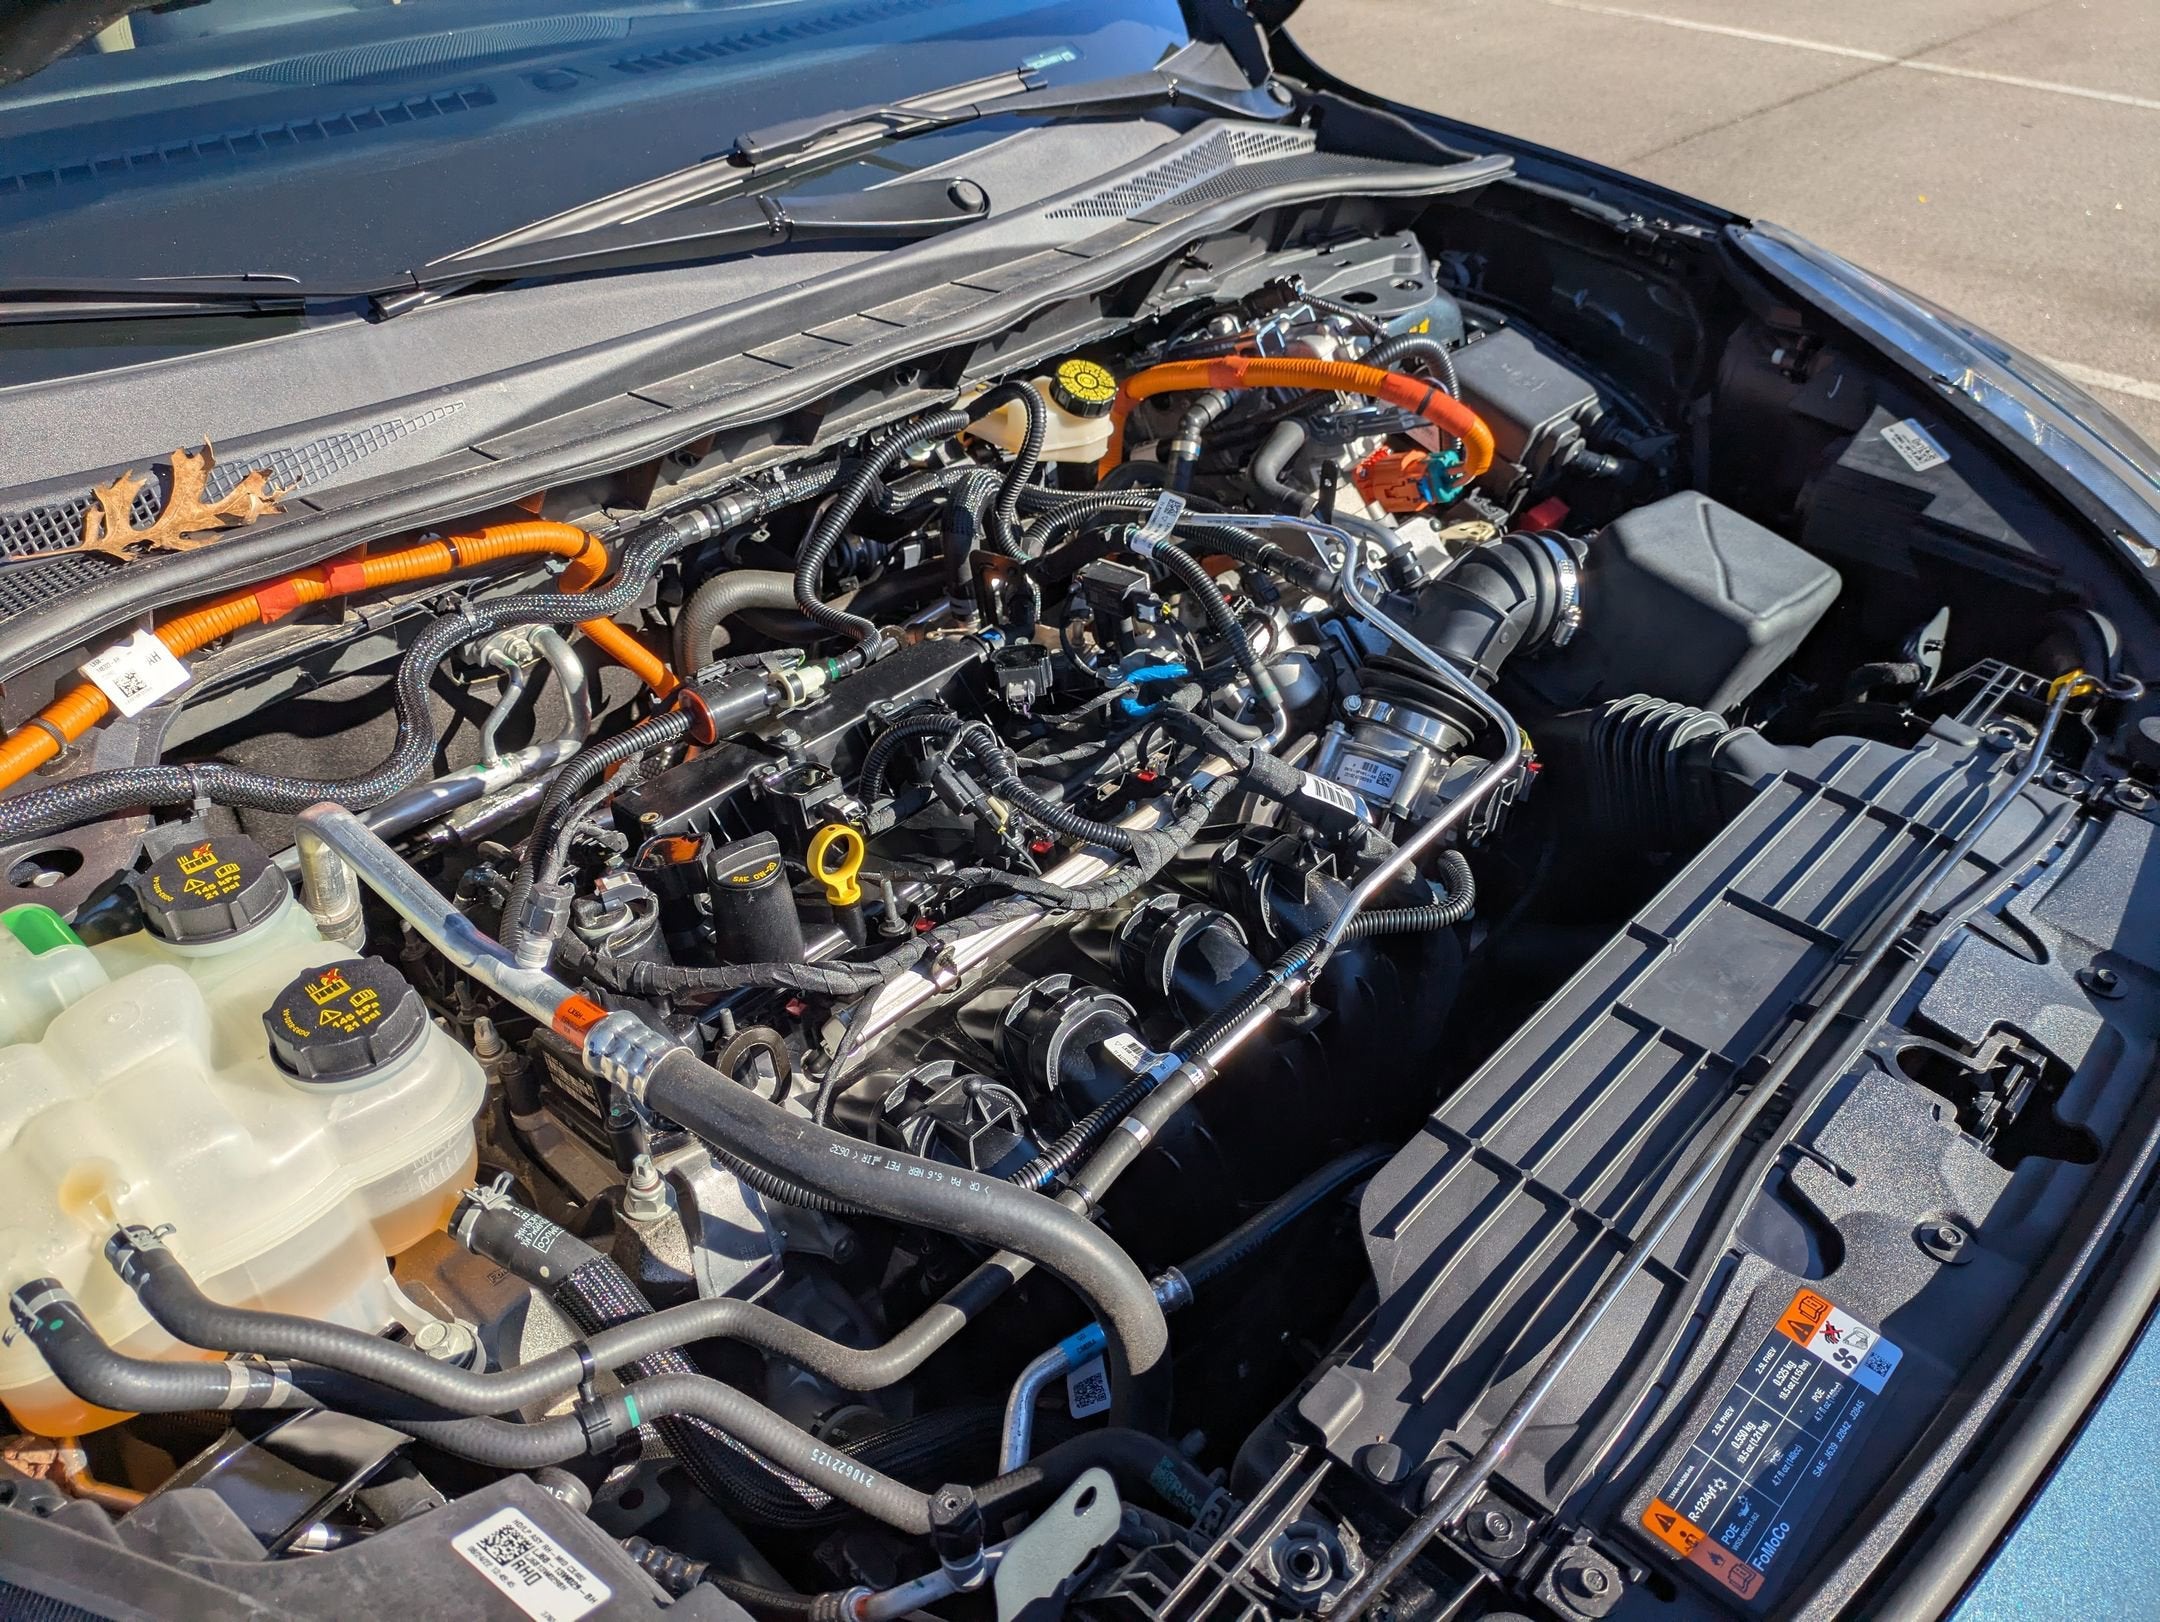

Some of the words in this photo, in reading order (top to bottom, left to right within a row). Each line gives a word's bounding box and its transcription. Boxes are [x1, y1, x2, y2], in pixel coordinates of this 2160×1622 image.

[194, 883, 217, 896] 145
[217, 874, 241, 887] kPa
[732, 874, 750, 883] SAE
[204, 889, 219, 900] 21
[221, 881, 241, 894] psi
[331, 1013, 355, 1028] 145
[355, 1001, 380, 1016] kPa
[344, 1021, 361, 1033] 21
[361, 1009, 381, 1024] psi
[884, 1160, 901, 1171] PET
[908, 1166, 924, 1177] NBR
[950, 1176, 961, 1187] PA
[969, 1182, 980, 1191] CR
[1755, 1361, 1767, 1374] 2.5L
[1762, 1346, 1777, 1363] FHEV
[1772, 1368, 1789, 1387] 0.525
[1783, 1360, 1796, 1371] kg
[1778, 1387, 1791, 1400] 18.5
[1787, 1381, 1796, 1390] oz
[1798, 1359, 1812, 1372] lbs)
[1811, 1387, 1825, 1402] POE
[1711, 1423, 1724, 1436] 2.5L
[1720, 1405, 1735, 1424] PHEV
[1813, 1409, 1824, 1422] 4.7
[1823, 1400, 1832, 1408] oz
[1731, 1430, 1748, 1449] 0.550
[1743, 1421, 1756, 1433] kg
[1757, 1419, 1771, 1434] lbs)
[1745, 1443, 1754, 1452] oz
[1749, 1430, 1763, 1446] (1.21
[1812, 1459, 1827, 1477] SAE
[1823, 1442, 1838, 1460] J639
[1834, 1421, 1852, 1442] J2842
[1848, 1399, 1865, 1420] J2845
[1736, 1449, 1750, 1464] 19.5
[1769, 1449, 1782, 1464] POE
[810, 1448, 875, 1488] 210622125
[1771, 1474, 1782, 1486] 4.7
[1781, 1464, 1790, 1472] oz
[1687, 1484, 1717, 1523] R-1234yf
[1721, 1523, 1740, 1545] POE
[1751, 1521, 1791, 1571] FoMoCo
